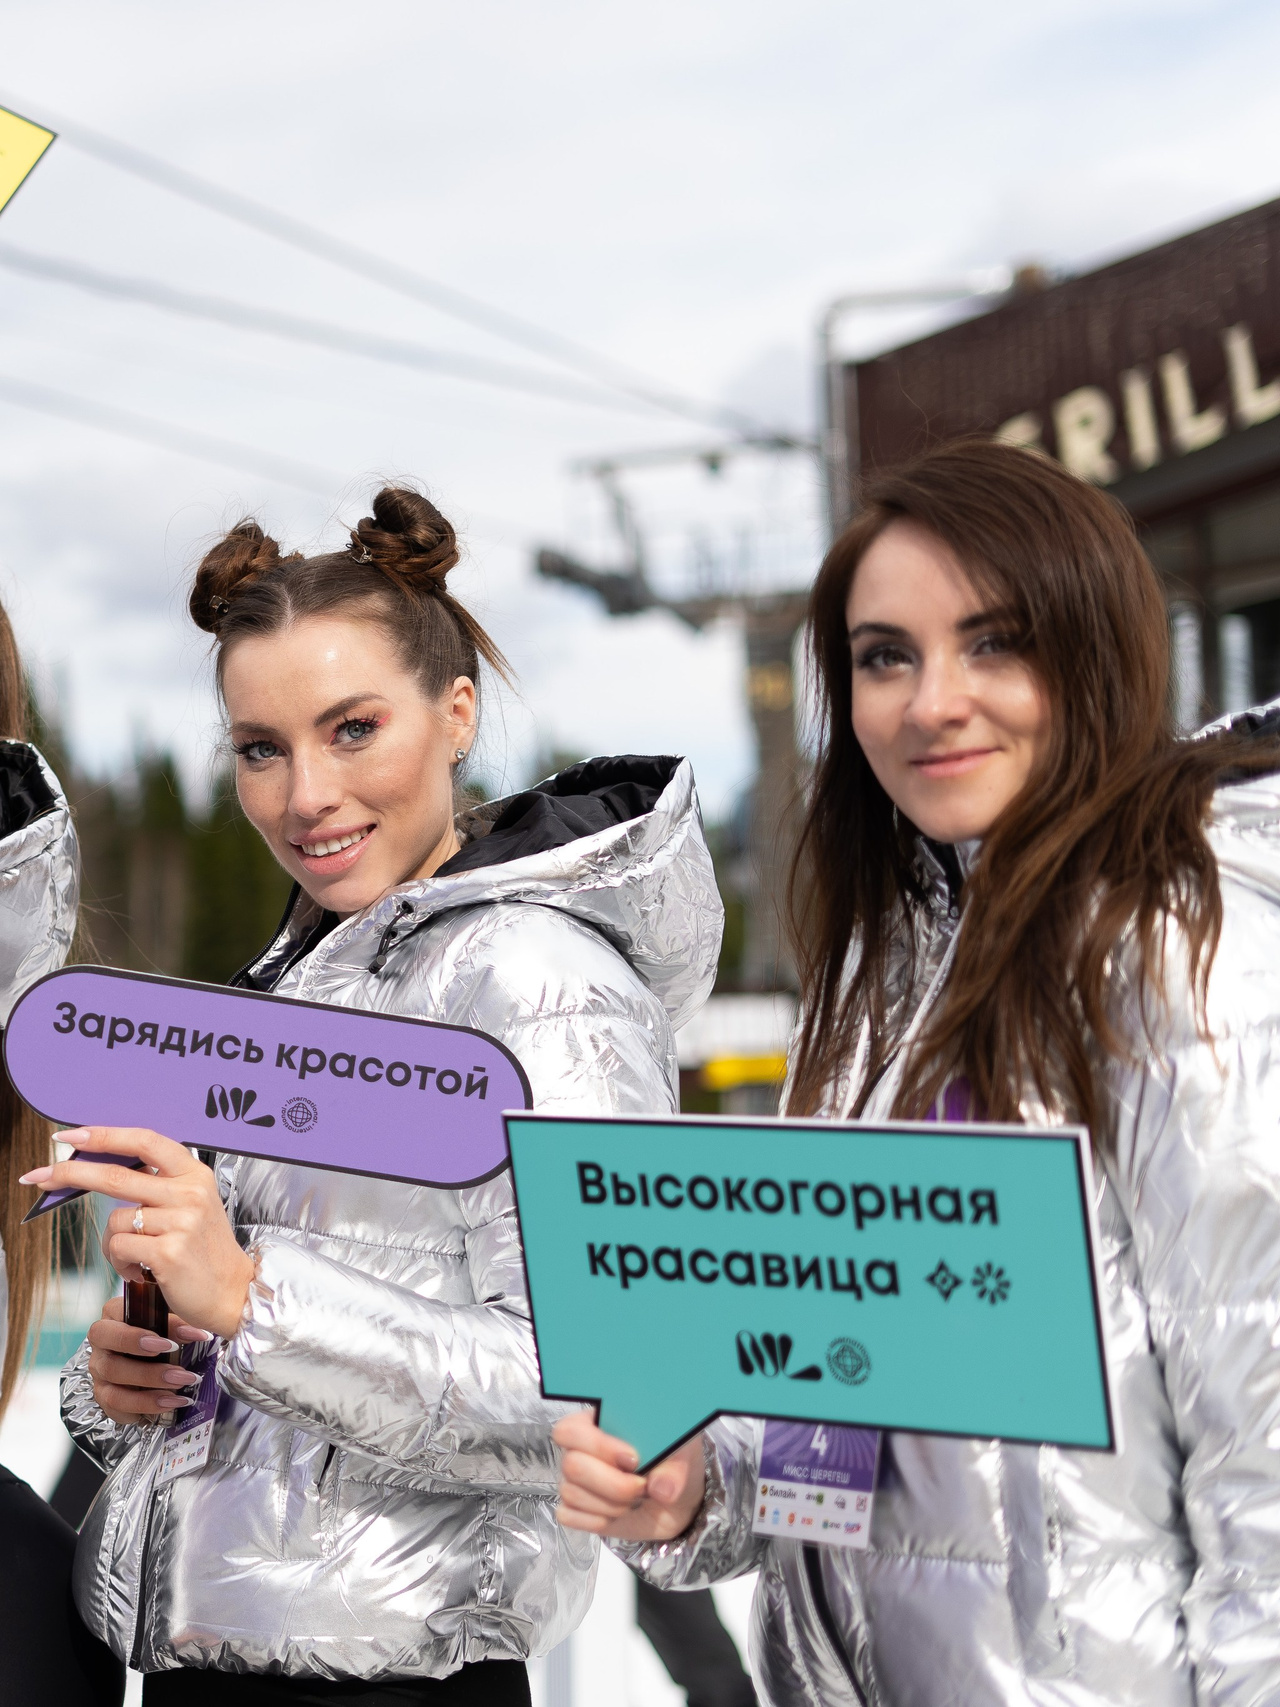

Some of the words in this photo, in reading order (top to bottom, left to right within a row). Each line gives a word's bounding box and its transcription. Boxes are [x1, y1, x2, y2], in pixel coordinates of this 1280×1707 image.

[53, 1001, 265, 1064] Зарядись
[275, 1043, 490, 1100] красотой
[576, 1161, 999, 1231] Высокогорная
[586, 1242, 900, 1301] красавица
[810, 1424, 828, 1456] 4
[782, 1464, 809, 1479] МИСС
